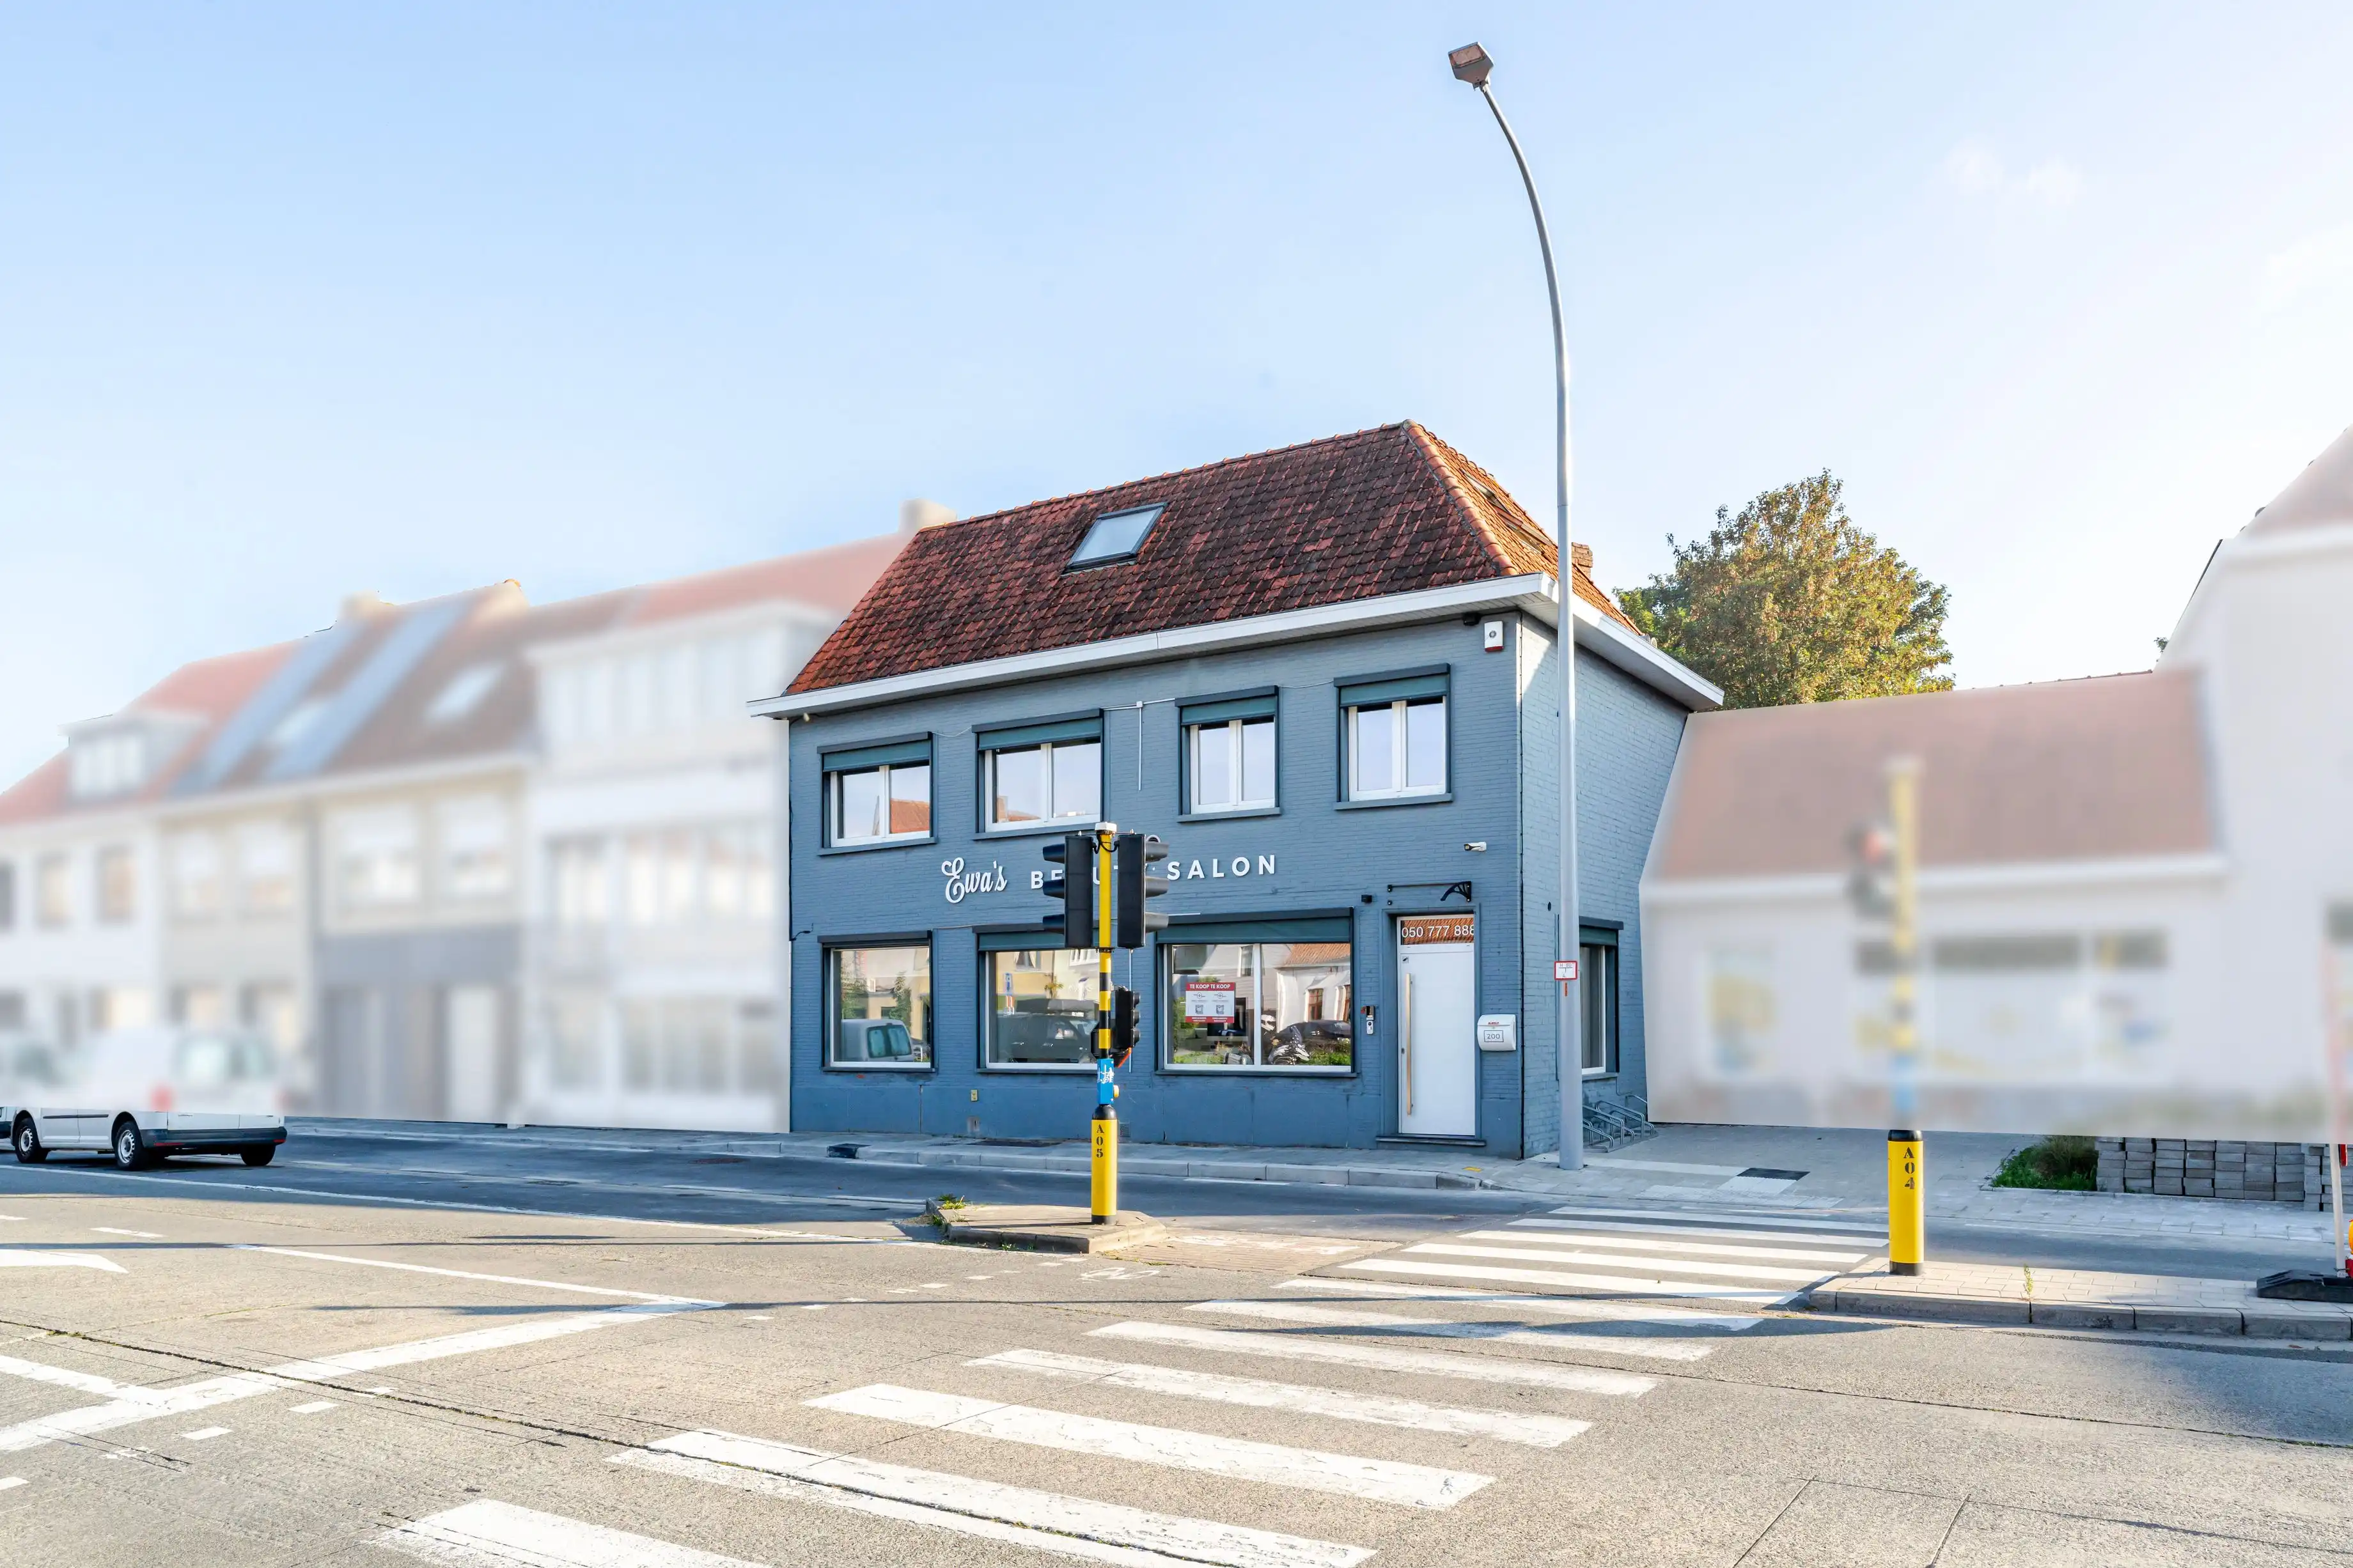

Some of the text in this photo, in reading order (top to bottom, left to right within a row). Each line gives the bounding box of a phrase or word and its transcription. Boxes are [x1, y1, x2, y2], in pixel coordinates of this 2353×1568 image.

[941, 857, 1008, 903] Ewa's
[1167, 855, 1275, 881] SALON
[1402, 927, 1423, 938] 050
[1428, 926, 1450, 936] 777
[1096, 1124, 1105, 1158] A05
[1903, 1147, 1916, 1190] A04
